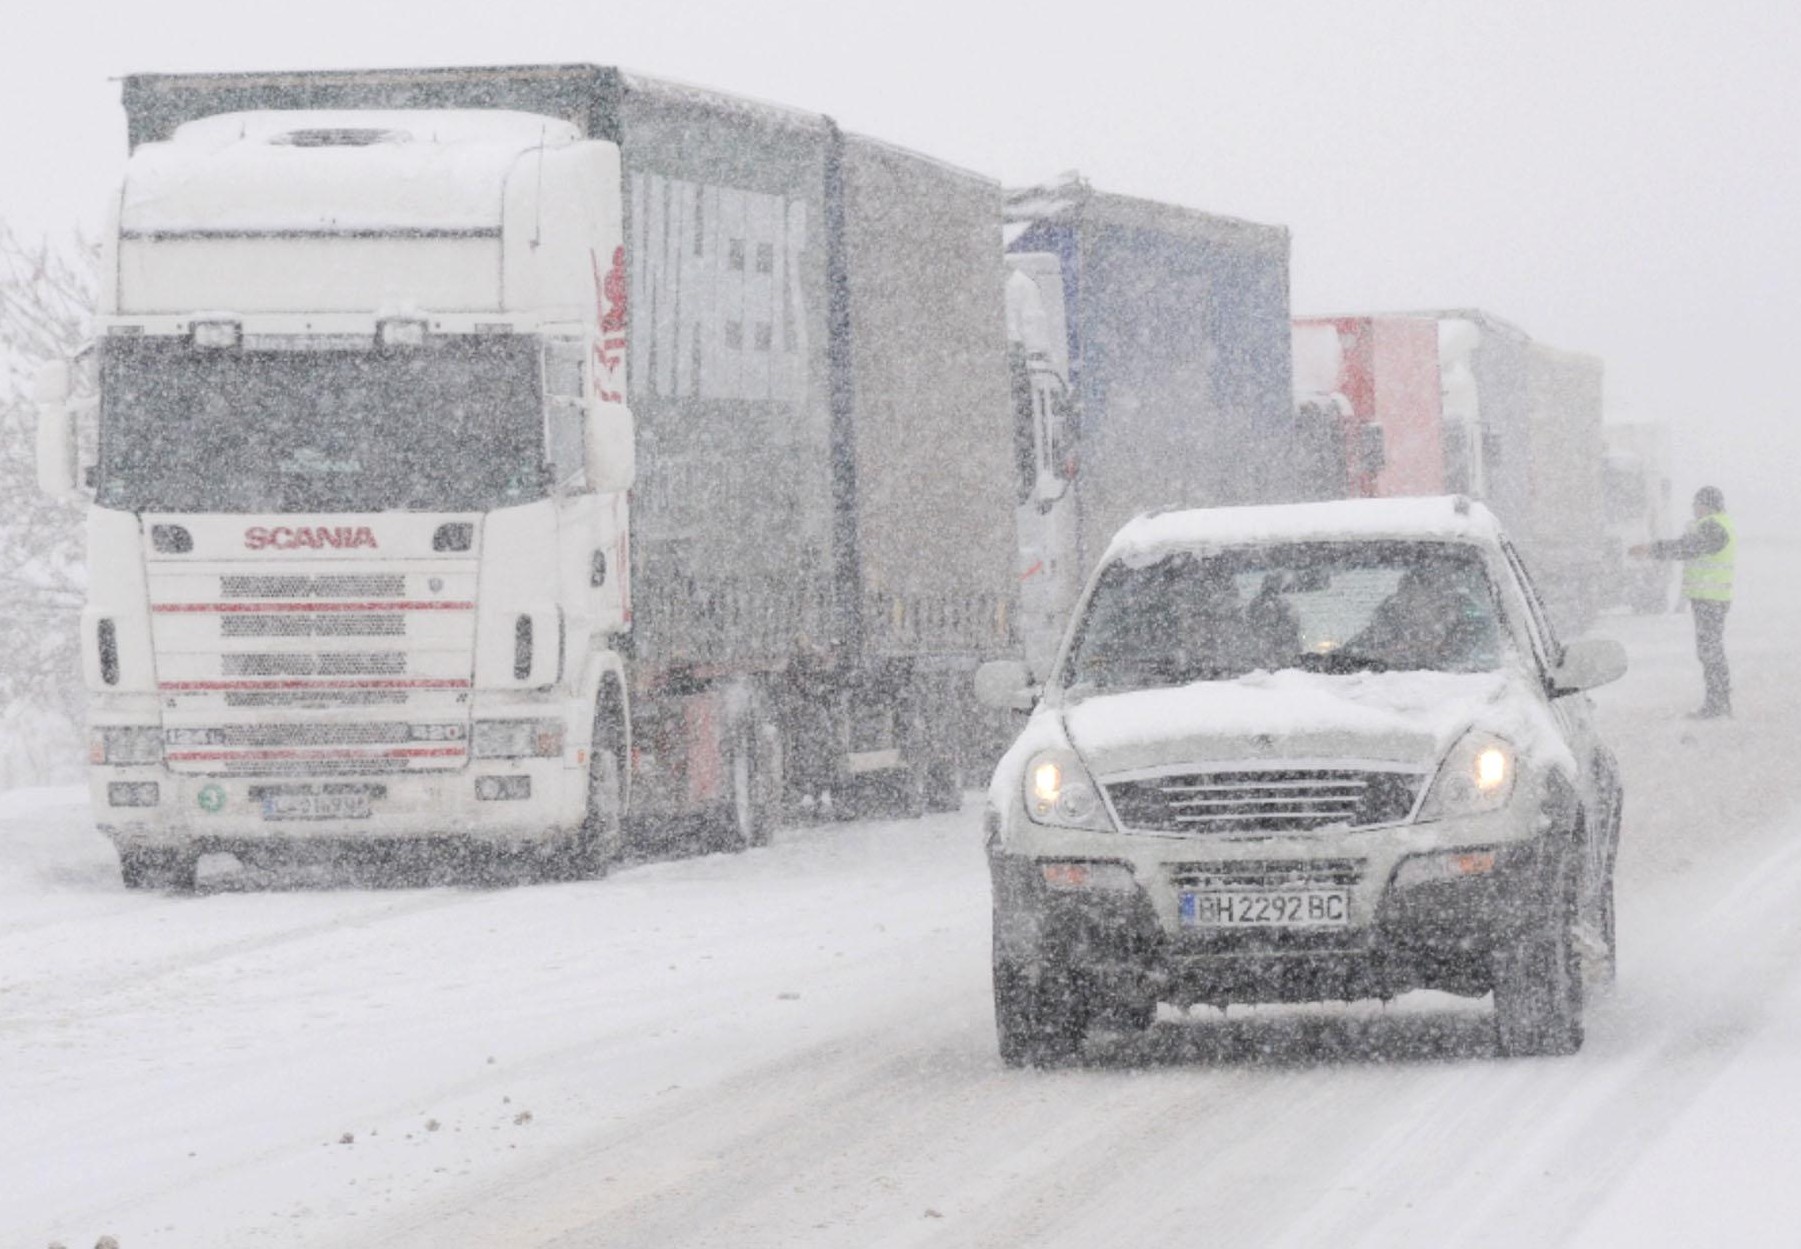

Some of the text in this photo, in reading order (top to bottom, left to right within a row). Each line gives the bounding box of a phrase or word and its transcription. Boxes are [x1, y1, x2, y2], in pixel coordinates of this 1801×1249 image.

[244, 526, 378, 549] SCANIA
[1239, 896, 1302, 922] 2292
[1308, 895, 1343, 920] BC
